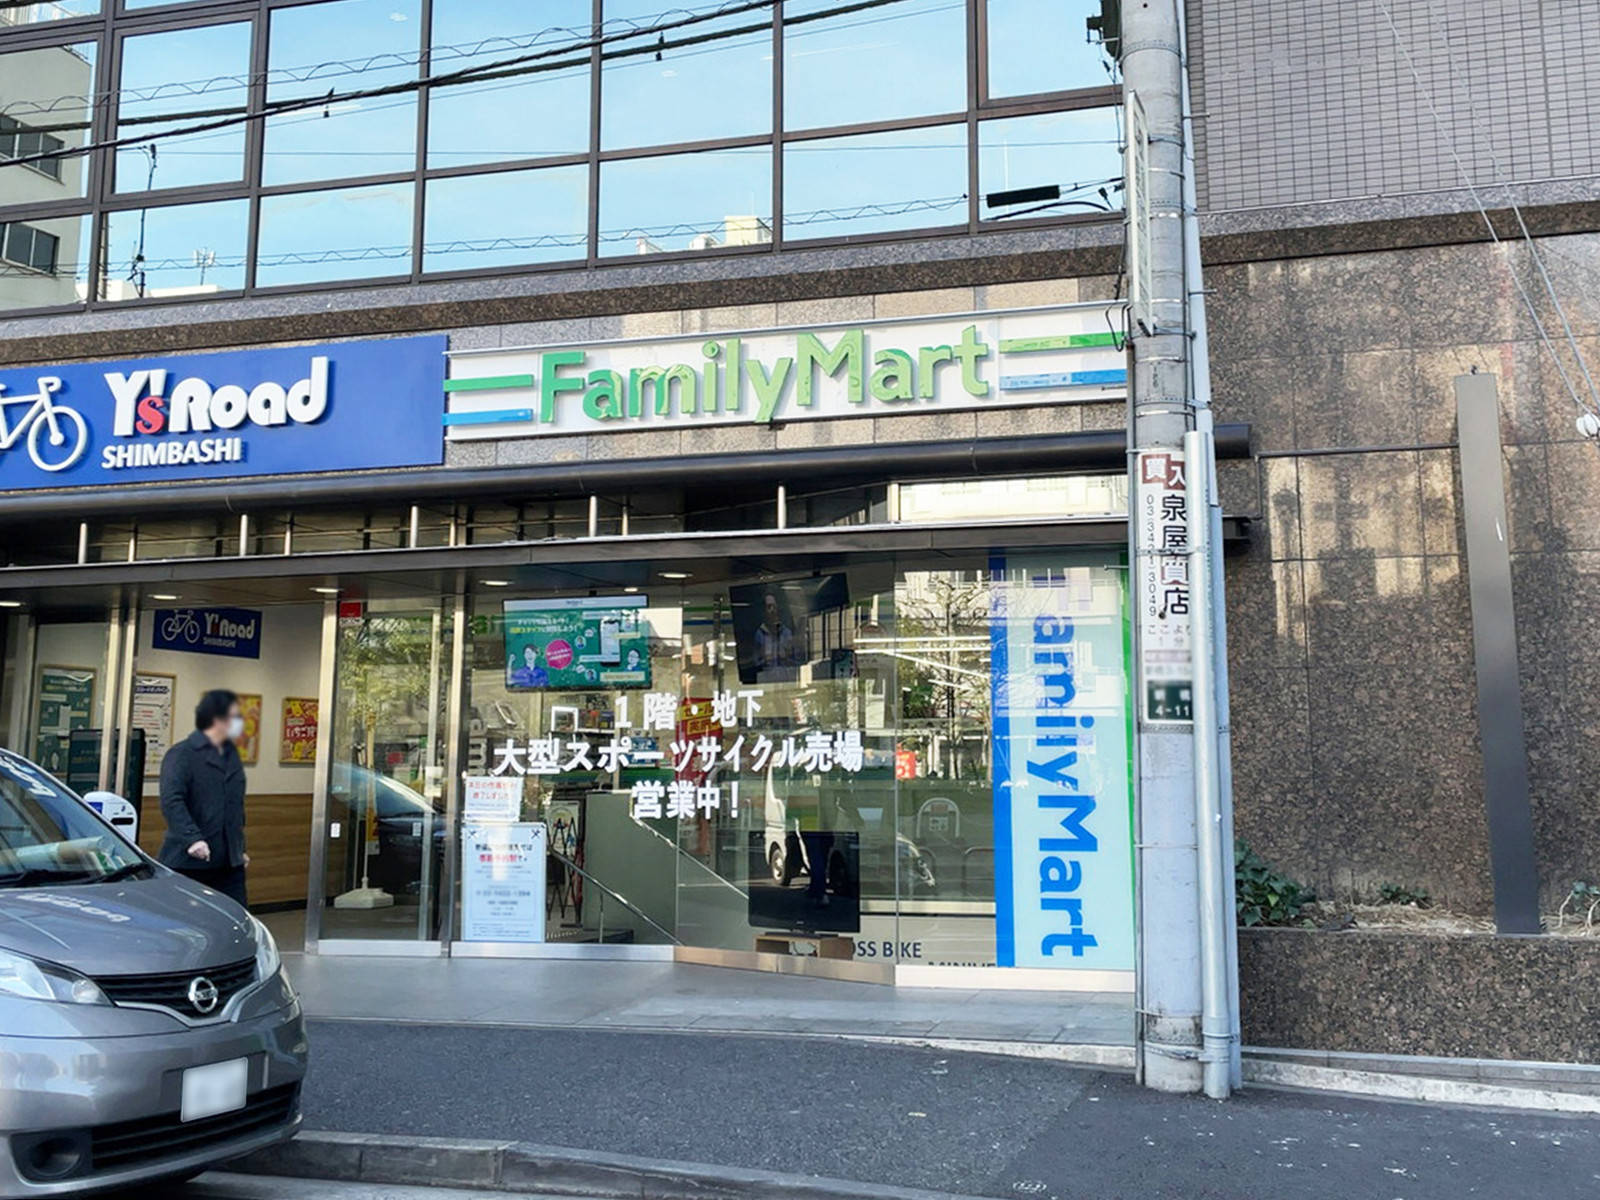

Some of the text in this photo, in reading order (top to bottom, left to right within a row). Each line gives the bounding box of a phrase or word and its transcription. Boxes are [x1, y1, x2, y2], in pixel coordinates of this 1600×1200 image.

[540, 324, 989, 424] FamilyMart
[101, 437, 243, 469] SHIMBASHI
[1155, 704, 1190, 716] 4-11
[492, 731, 864, 775] 大型スポーツサイクル売場
